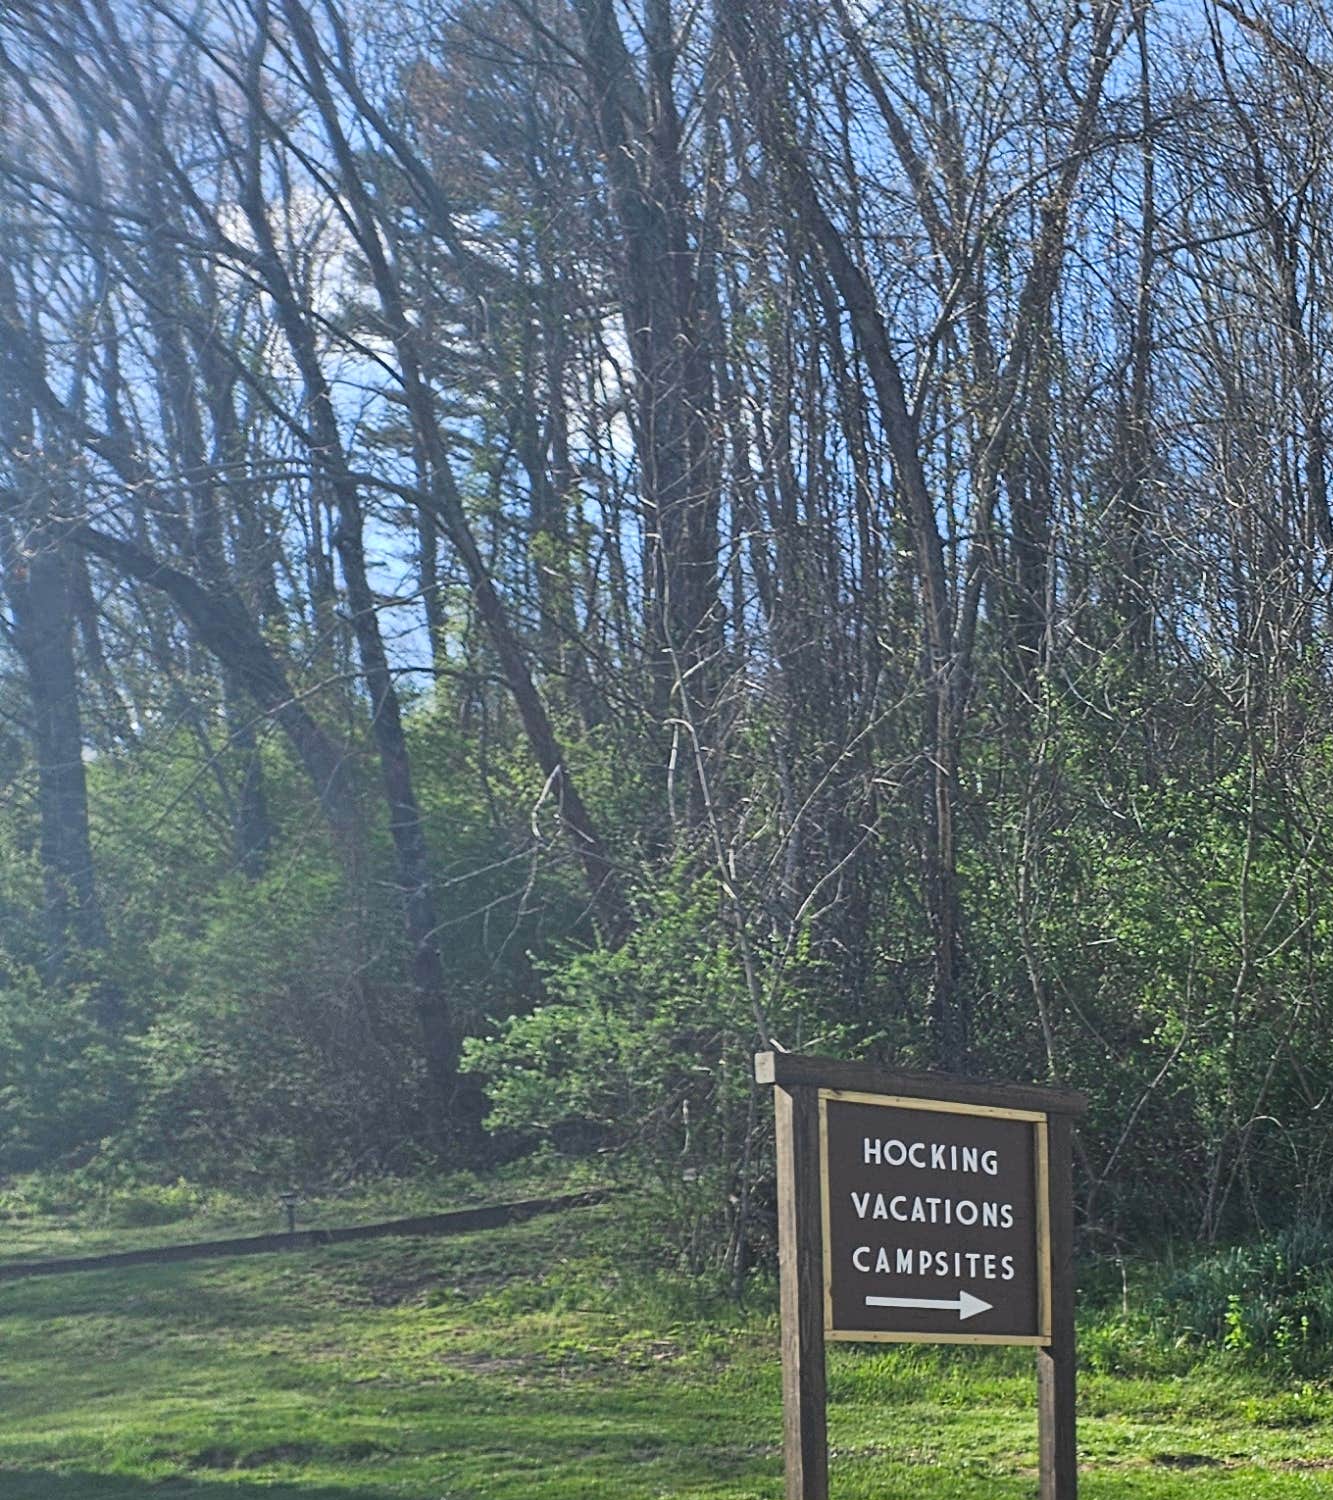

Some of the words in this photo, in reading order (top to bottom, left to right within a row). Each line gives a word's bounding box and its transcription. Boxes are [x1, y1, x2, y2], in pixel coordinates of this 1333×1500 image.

[864, 1137, 998, 1175] HOCKING
[851, 1191, 1014, 1228] VACATIONS
[852, 1246, 1015, 1280] CAMPSITES
